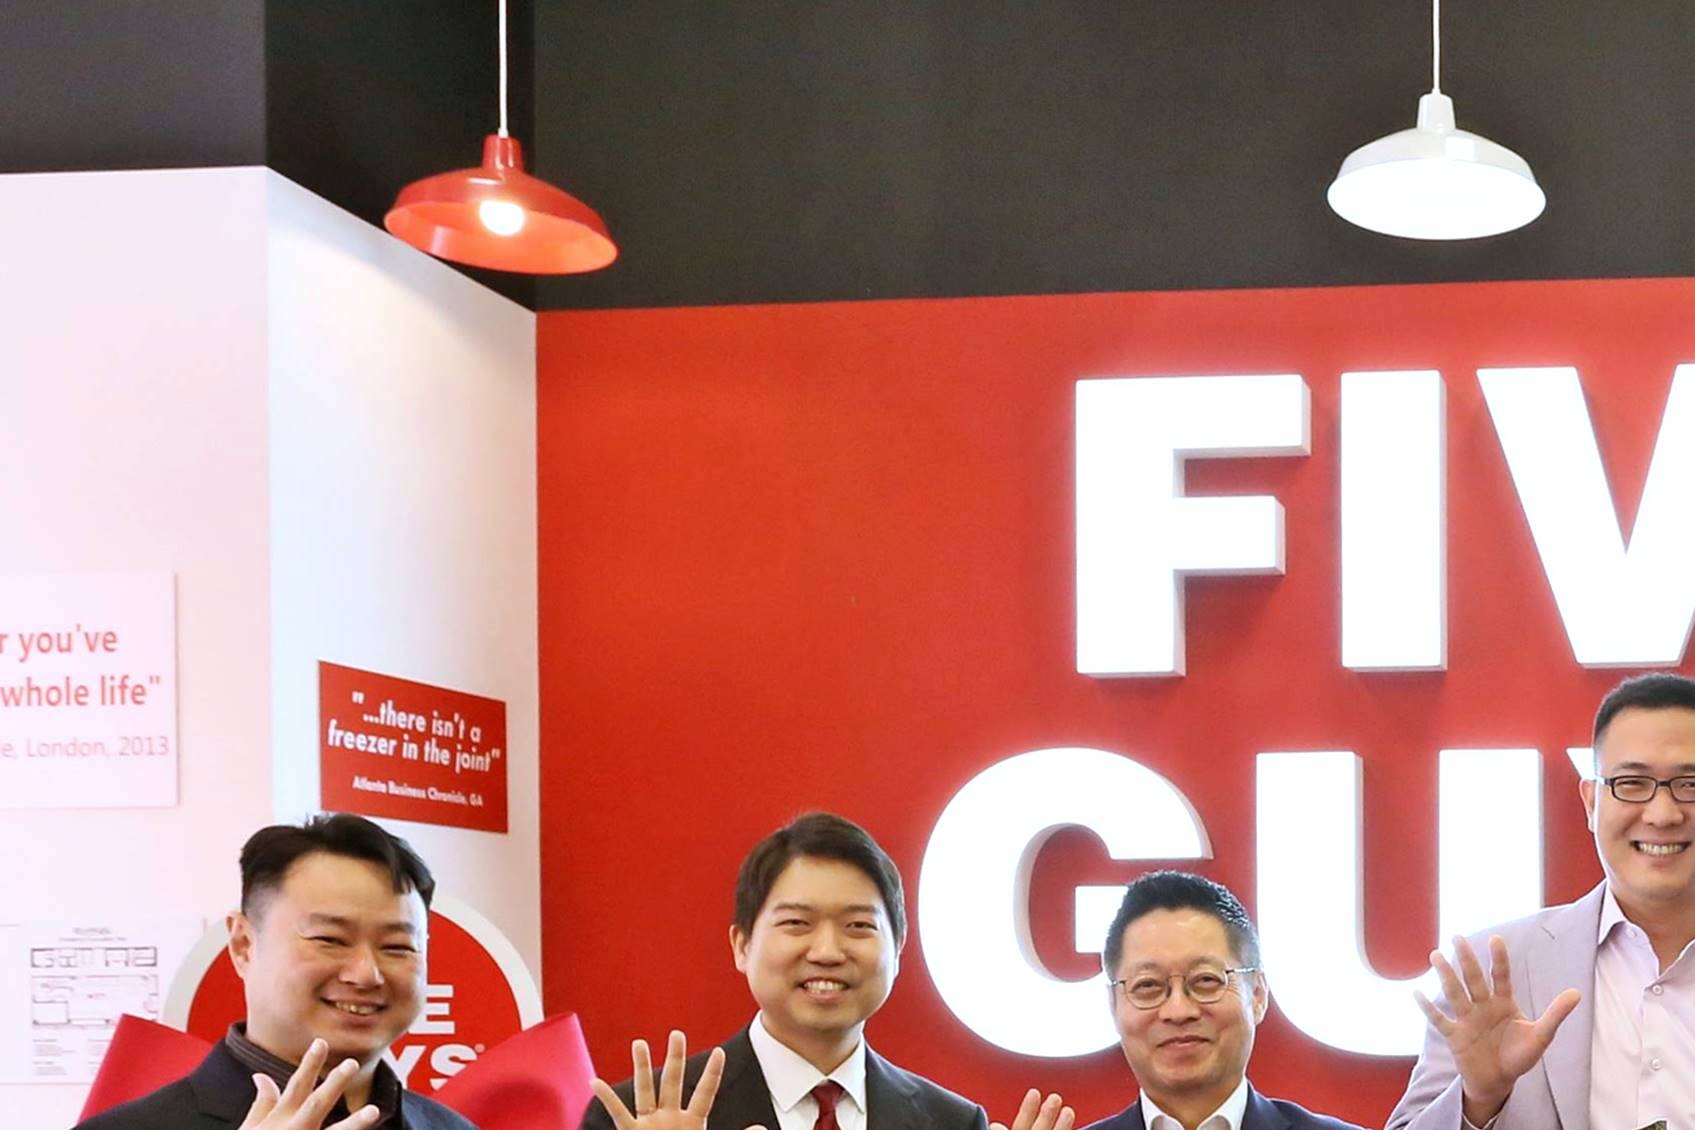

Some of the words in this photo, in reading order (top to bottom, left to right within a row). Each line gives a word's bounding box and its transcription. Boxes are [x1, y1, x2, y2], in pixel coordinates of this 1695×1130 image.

[18, 623, 119, 663] you've
[0, 676, 90, 707] whole
[100, 674, 161, 706] life"
[432, 710, 466, 740] isn't
[470, 726, 482, 744] a
[119, 735, 170, 757] 2013
[327, 718, 397, 756] freezer
[402, 734, 418, 760] in
[424, 737, 450, 765] the
[455, 744, 501, 774] joint"
